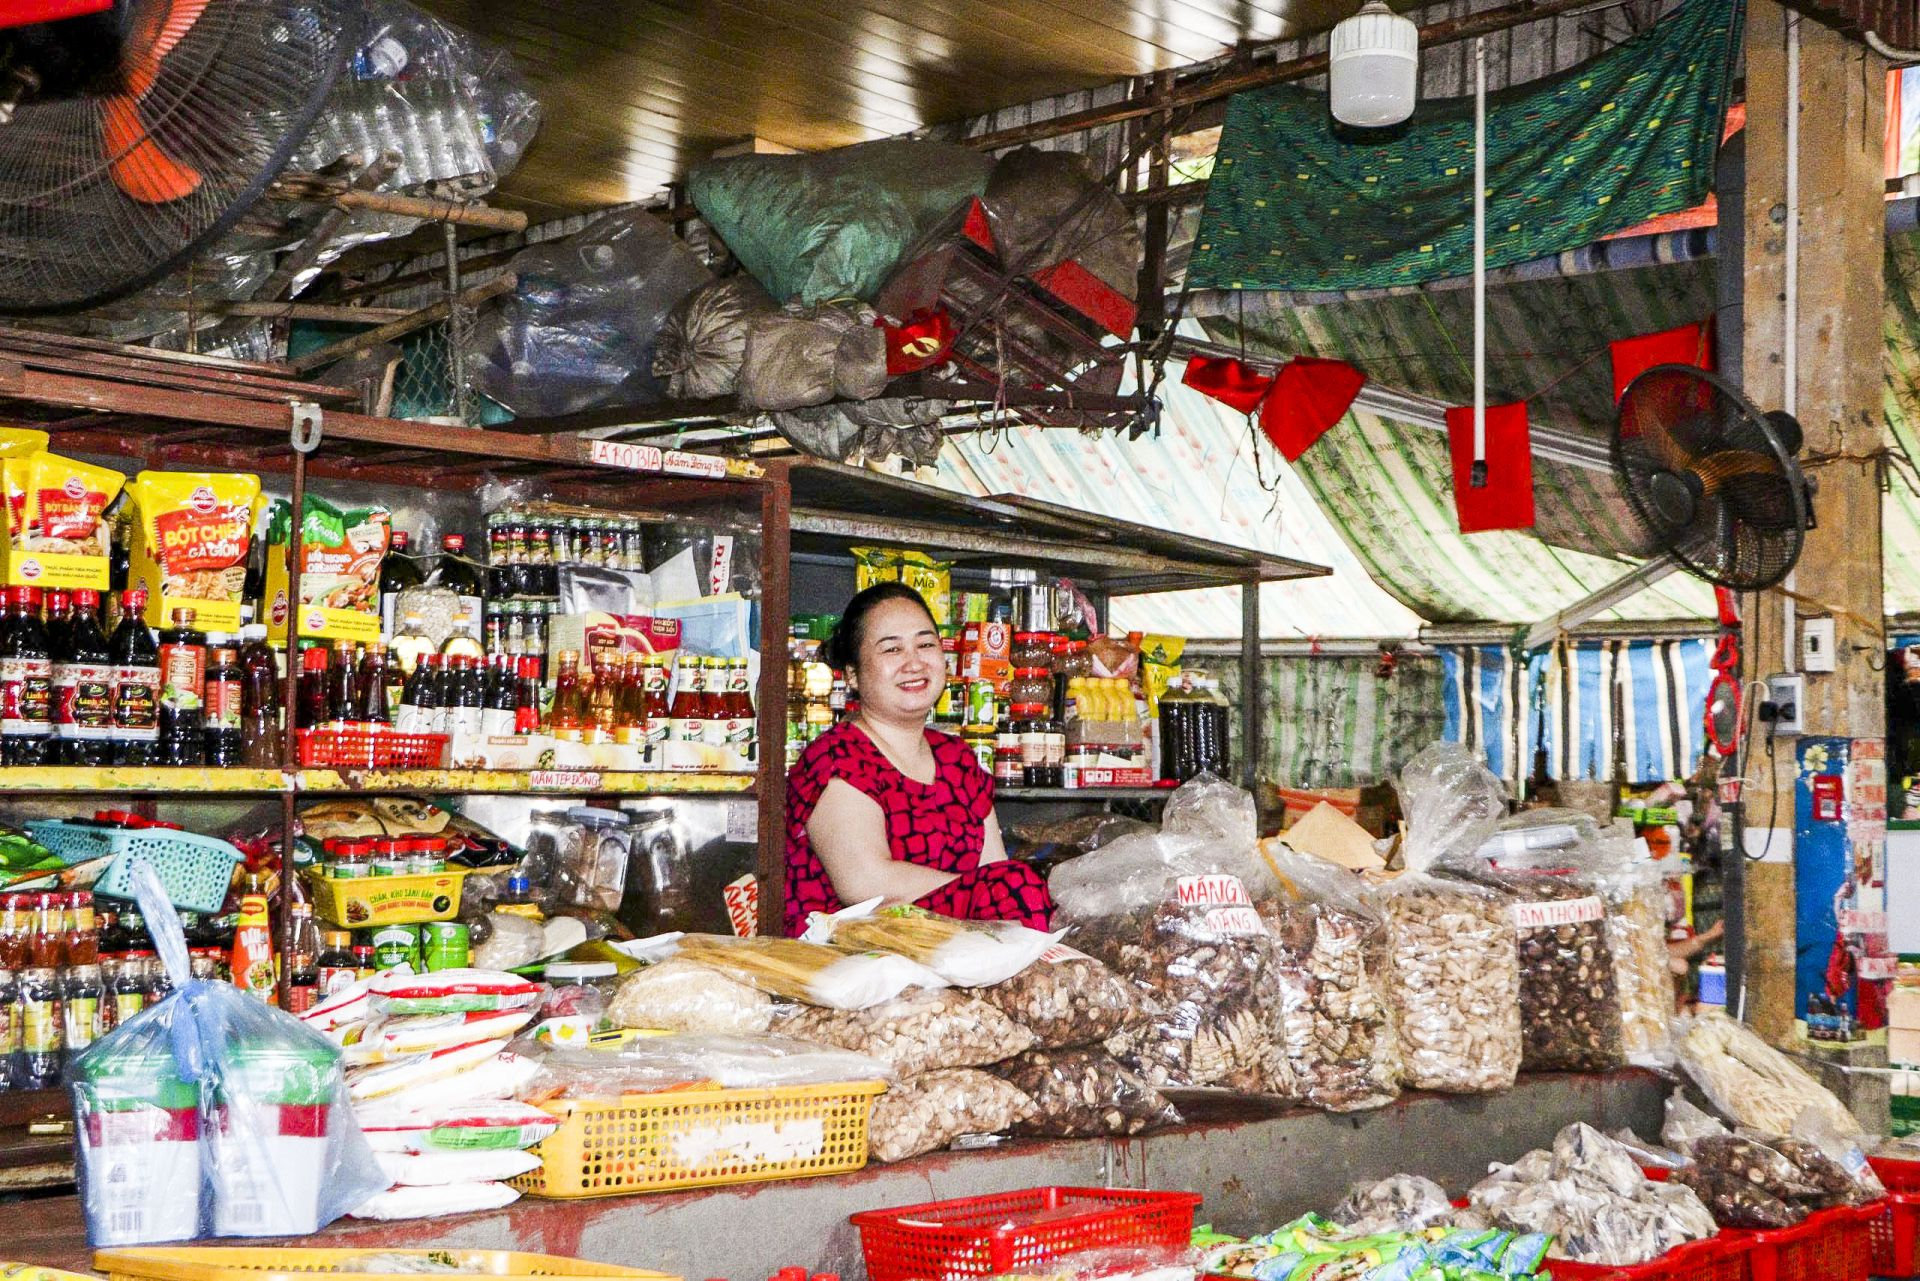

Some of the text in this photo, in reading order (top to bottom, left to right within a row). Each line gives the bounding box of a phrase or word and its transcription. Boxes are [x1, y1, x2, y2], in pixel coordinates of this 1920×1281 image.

[164, 522, 200, 549] BỘT
[188, 542, 208, 559] GÀ
[913, 576, 935, 589] Mía
